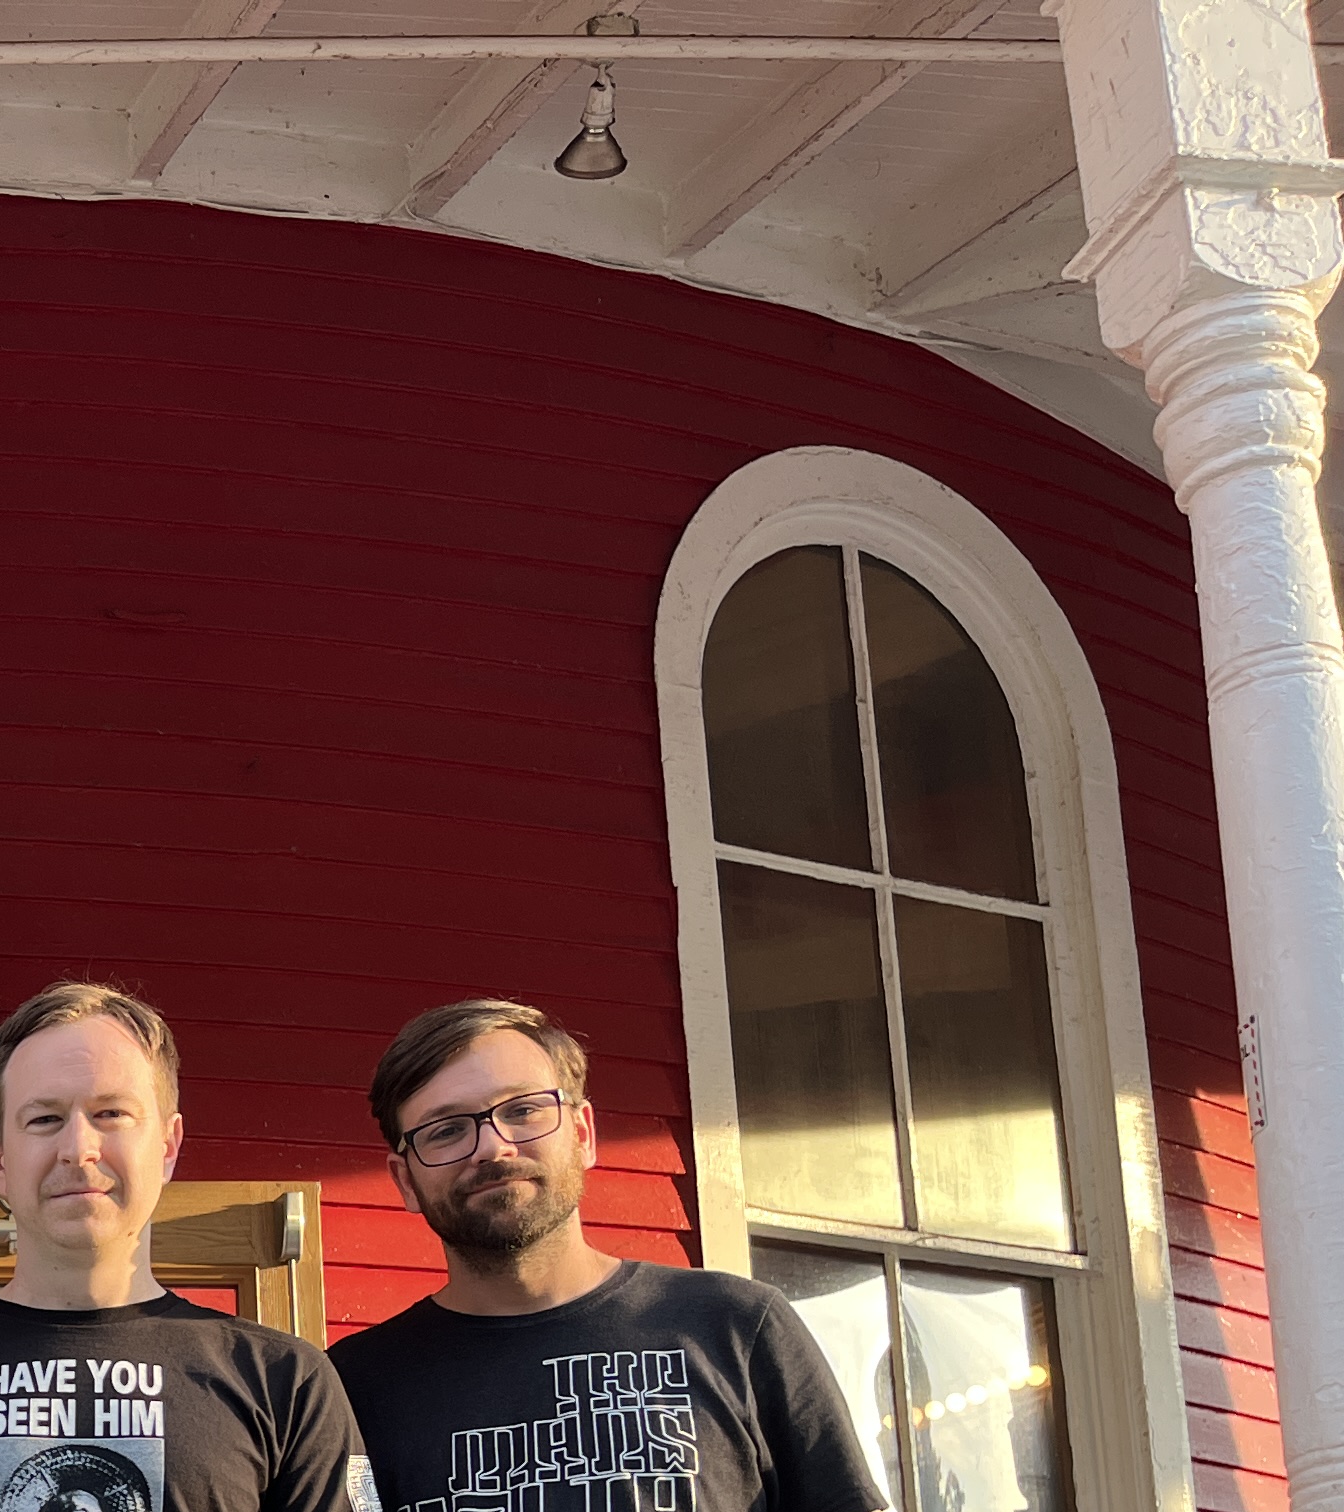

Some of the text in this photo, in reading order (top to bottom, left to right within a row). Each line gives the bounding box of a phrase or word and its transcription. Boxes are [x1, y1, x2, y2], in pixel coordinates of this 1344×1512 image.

[85, 1359, 164, 1396] YOU
[542, 1349, 692, 1417] THE
[93, 1398, 165, 1437] HIM
[448, 1408, 700, 1494] MARS
